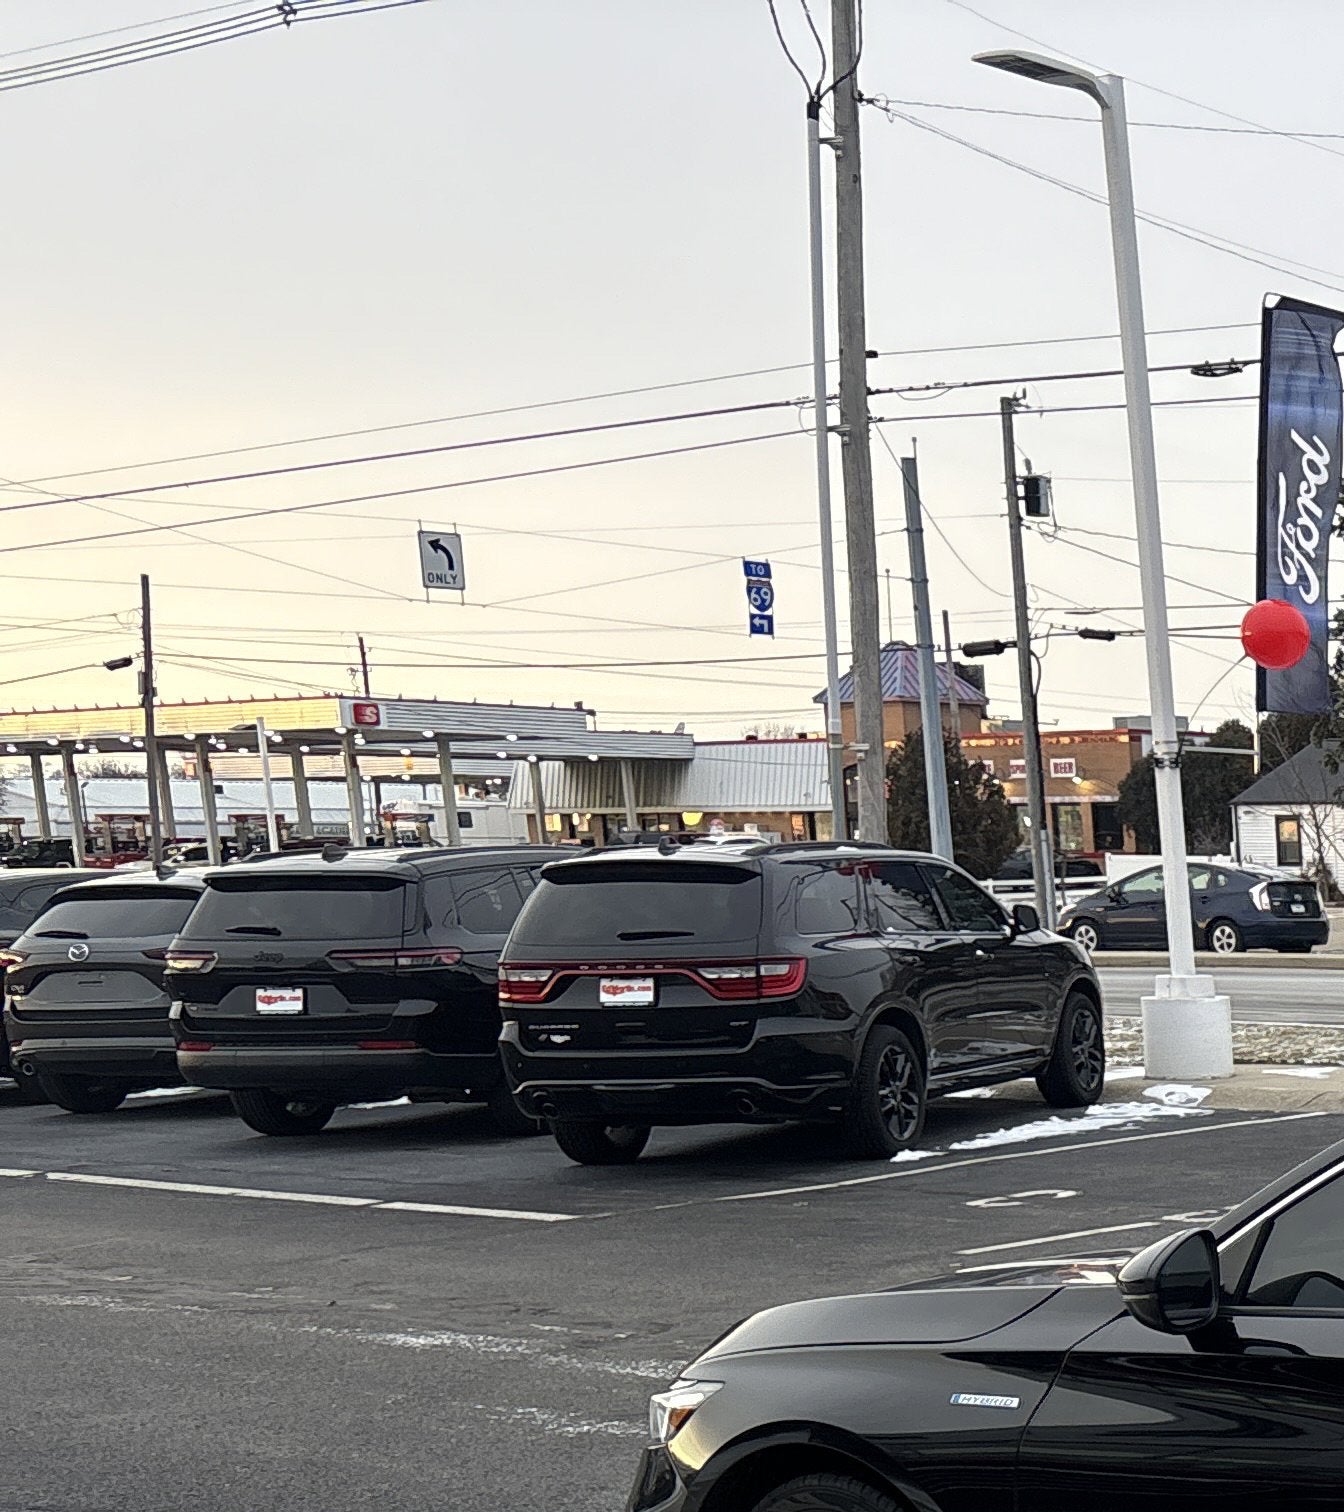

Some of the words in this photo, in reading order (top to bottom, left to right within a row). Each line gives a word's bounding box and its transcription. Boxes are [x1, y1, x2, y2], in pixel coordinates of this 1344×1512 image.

[1278, 428, 1331, 605] Ford
[750, 563, 765, 575] TO
[427, 572, 458, 585] ONLY
[750, 587, 771, 606] 69
[1052, 762, 1074, 774] BEER
[960, 1395, 1014, 1406] HYBRID
